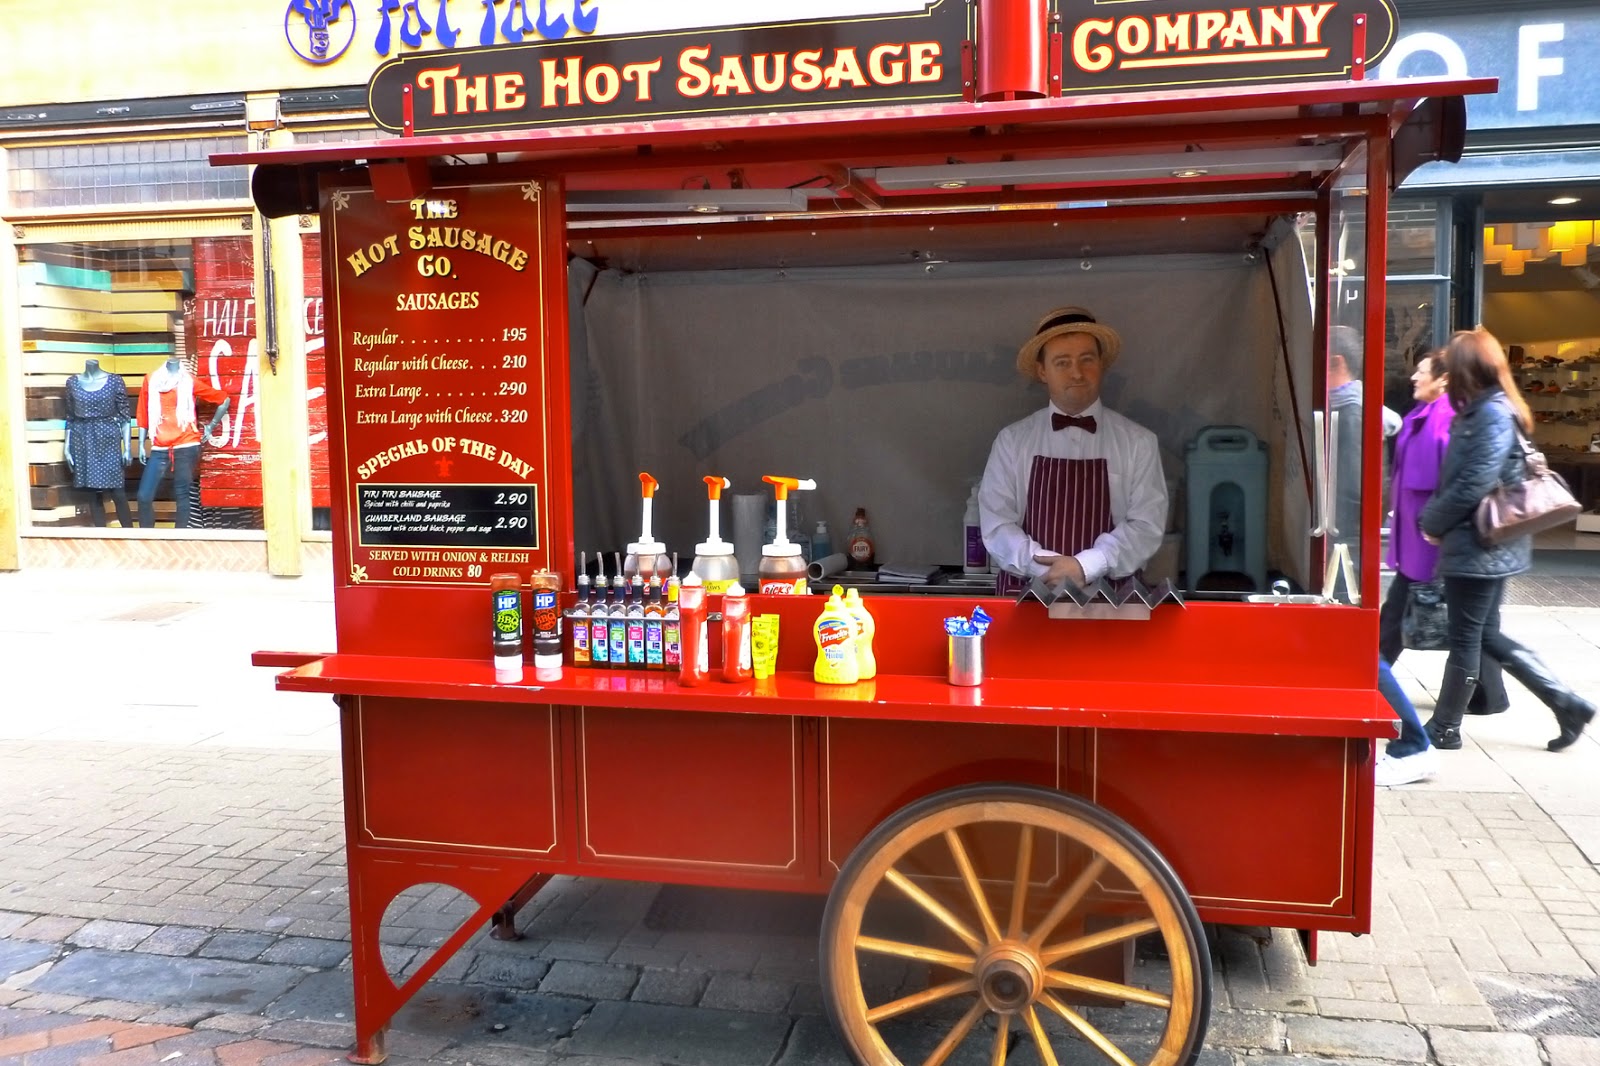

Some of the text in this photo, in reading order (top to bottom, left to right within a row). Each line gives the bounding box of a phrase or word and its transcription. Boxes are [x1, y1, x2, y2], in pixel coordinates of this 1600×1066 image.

[416, 2, 1338, 116] THE HOT SAUSAGE COMPANY
[410, 198, 458, 219] THE
[346, 225, 529, 277] HOT SAUSAGE
[417, 255, 458, 279] CO.
[396, 291, 480, 311] SAUSAGES
[203, 299, 256, 337] HALF
[353, 328, 398, 351] Regular
[354, 354, 399, 378] Regular
[401, 354, 428, 370] with
[431, 353, 469, 370] Cheese
[355, 384, 386, 398] Extra
[389, 382, 422, 404] Large
[356, 410, 388, 424] Extra
[390, 410, 423, 430] Large
[425, 407, 452, 424] with
[454, 407, 493, 423] Cheese
[357, 436, 535, 480] SPECIAL OF THE DAY
[363, 500, 451, 510] Spiced with chilli and paprika
[398, 490, 442, 500] SAUSAGE
[494, 492, 528, 505] 2.90
[364, 514, 528, 529] CUMBERLAND SAUSAGE 2.90
[364, 524, 392, 533] Seasoned
[393, 524, 407, 532] with
[428, 524, 444, 533] black
[445, 525, 464, 535] pepper
[466, 525, 478, 533] and
[369, 550, 529, 563] SERVED WITH ONION & RELISH
[393, 565, 482, 578] COLD DRINKS 80
[498, 597, 517, 609] HP
[536, 594, 554, 607] HP
